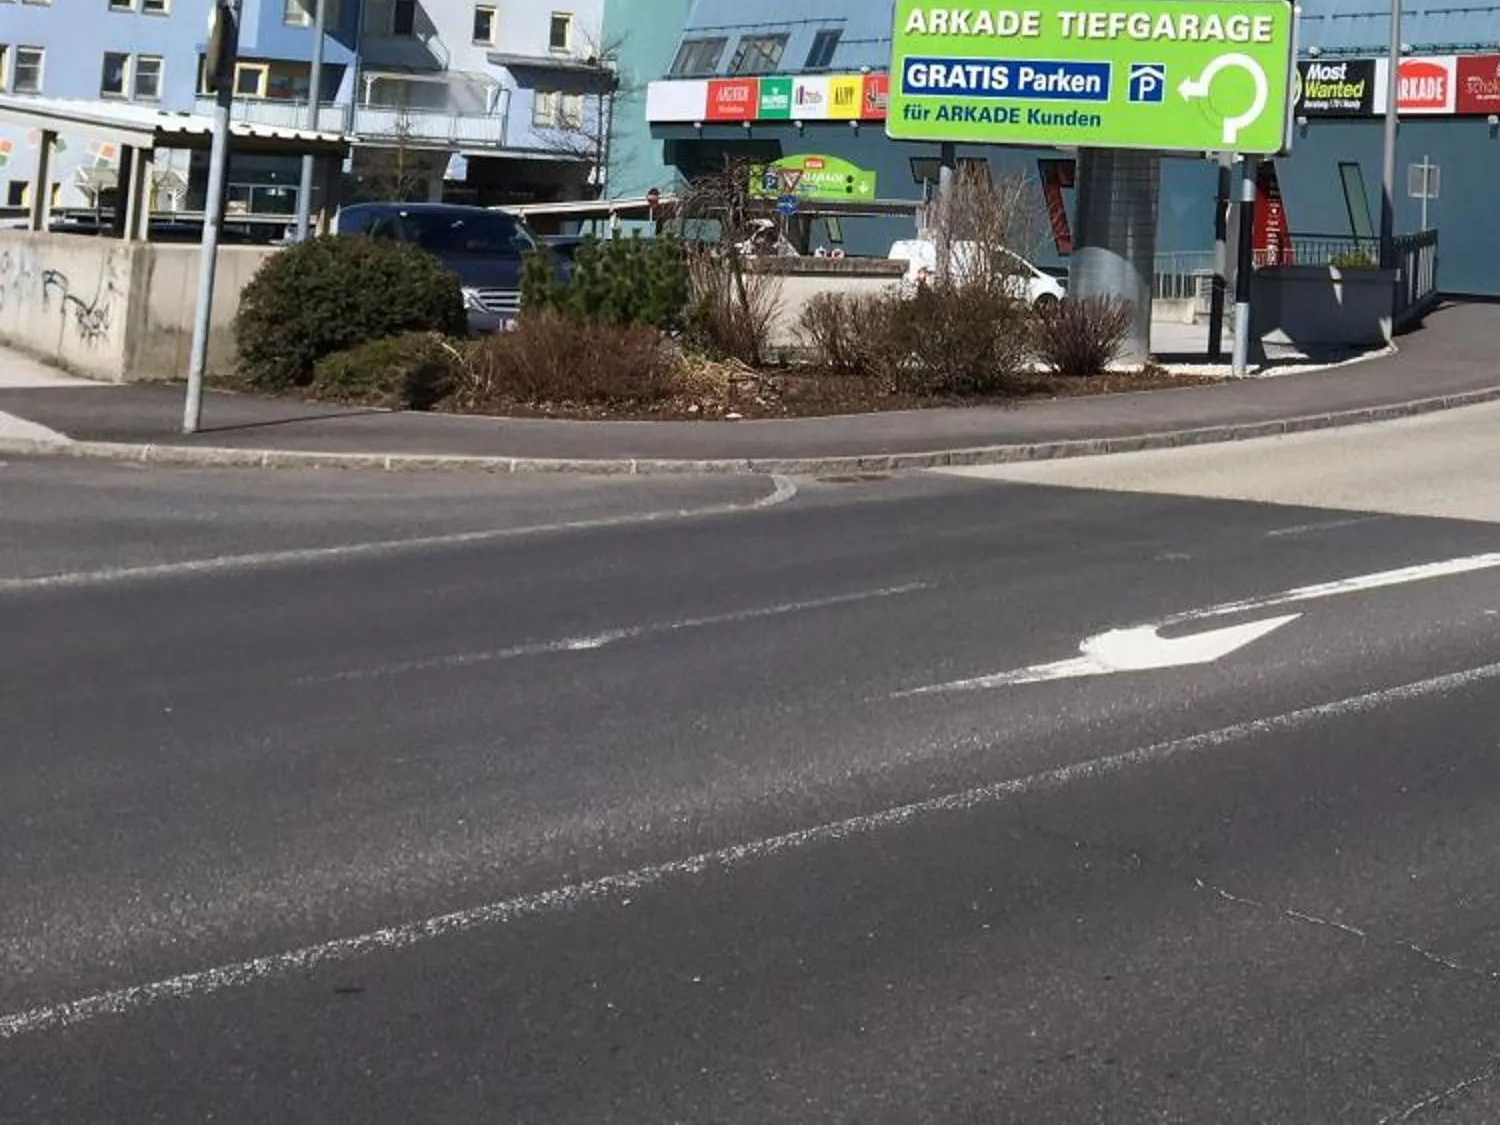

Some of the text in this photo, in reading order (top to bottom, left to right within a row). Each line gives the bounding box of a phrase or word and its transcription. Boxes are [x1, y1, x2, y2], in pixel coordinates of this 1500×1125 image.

[904, 8, 1273, 43] ARKADE TIEFGARAGE
[906, 63, 1101, 94] GRATIS Parken
[1306, 62, 1347, 81] Most
[1305, 79, 1365, 99] Wanted
[903, 106, 1101, 128] für ARKADE Kunden
